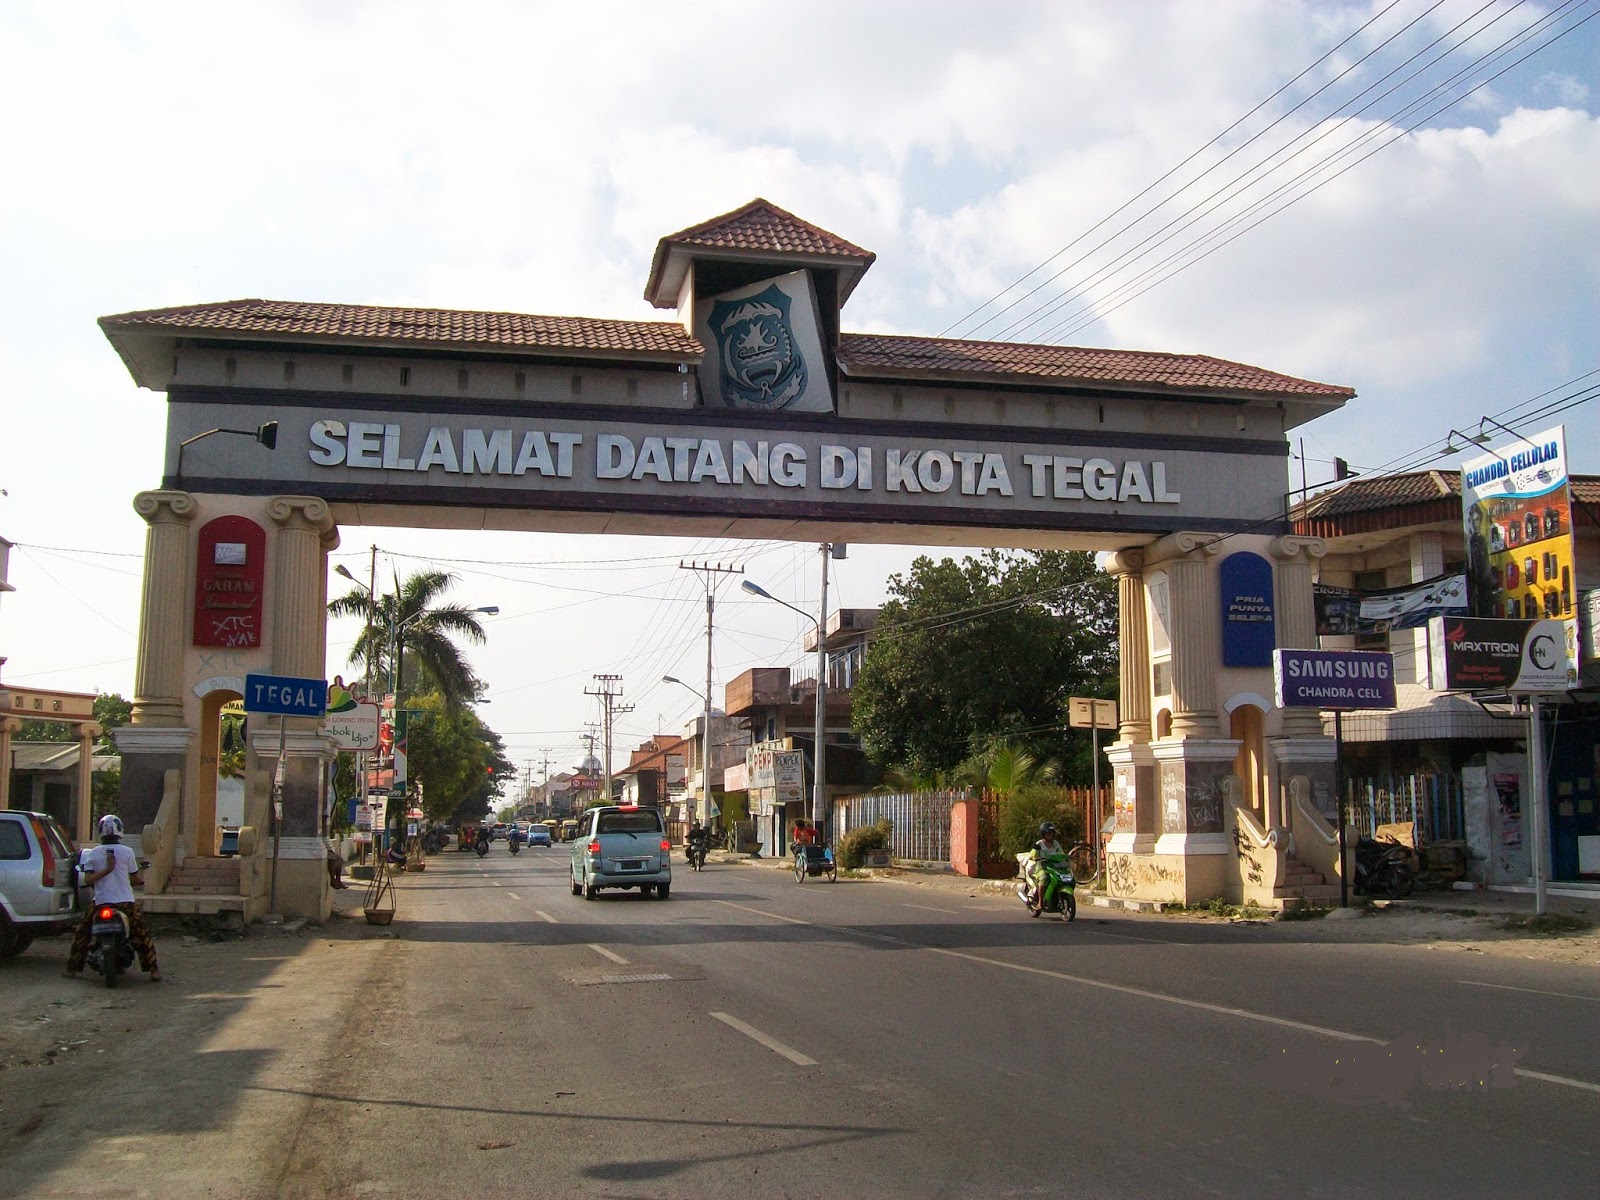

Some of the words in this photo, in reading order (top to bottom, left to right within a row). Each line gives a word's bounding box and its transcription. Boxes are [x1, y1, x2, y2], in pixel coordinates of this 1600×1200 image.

[308, 419, 583, 478] SELAMAT
[596, 433, 807, 489] DATANG
[819, 444, 873, 491] DI
[885, 447, 1015, 497] KOTA
[1023, 453, 1181, 504] TEGAL
[1466, 458, 1510, 490] CHANDRA
[1510, 441, 1559, 474] CELLULAR
[203, 579, 256, 593] GARAM
[1229, 604, 1271, 612] PUNYA
[212, 615, 254, 636] XTC
[1453, 641, 1520, 653] MAXTRON
[1288, 658, 1389, 679] SAMSUNG
[254, 684, 318, 708] TEGAL
[1298, 686, 1355, 698] CHANDRA
[1357, 687, 1382, 699] CELL
